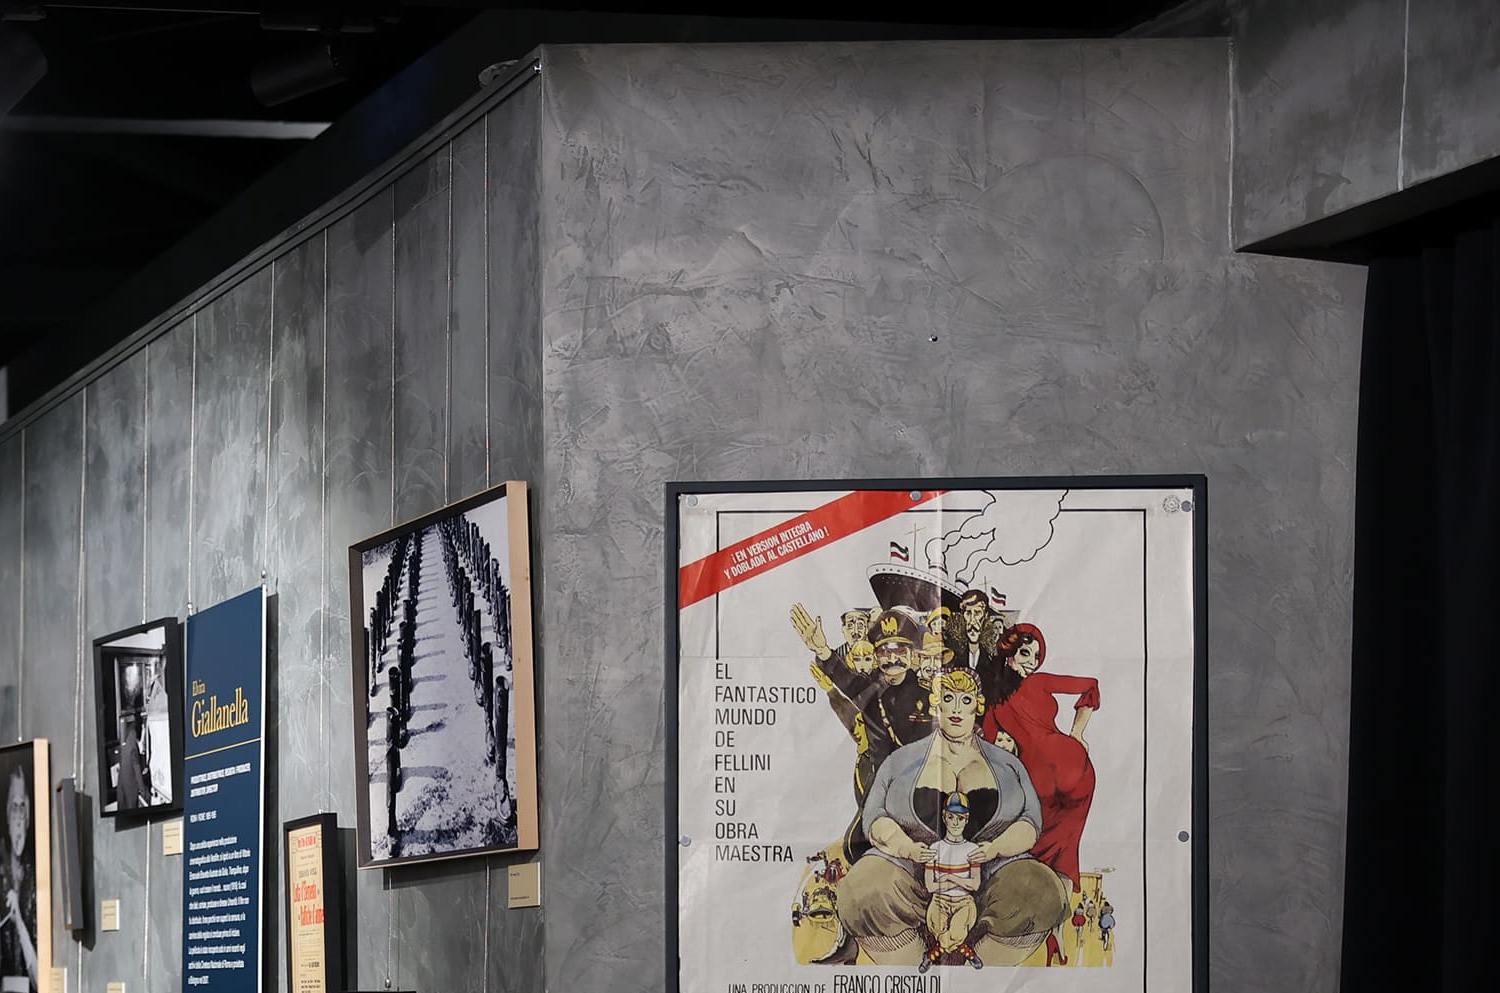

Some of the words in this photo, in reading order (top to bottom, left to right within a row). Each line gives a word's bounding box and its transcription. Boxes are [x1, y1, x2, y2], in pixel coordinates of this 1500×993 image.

[746, 534, 780, 557] VERSION
[780, 521, 813, 543] INTEGRA
[724, 569, 731, 580] Y
[731, 554, 767, 577] DOBLADA
[767, 548, 778, 562] AL
[715, 663, 732, 680] EL
[715, 686, 816, 704] FANTASTICO
[191, 687, 249, 738] Giallanella
[715, 708, 776, 726] MUNDO
[715, 731, 735, 748] DE
[715, 754, 770, 771] FELLINI
[715, 776, 735, 793] EN
[715, 799, 736, 816] SU
[715, 822, 758, 839] OBRA
[715, 845, 794, 862] MAESTRA
